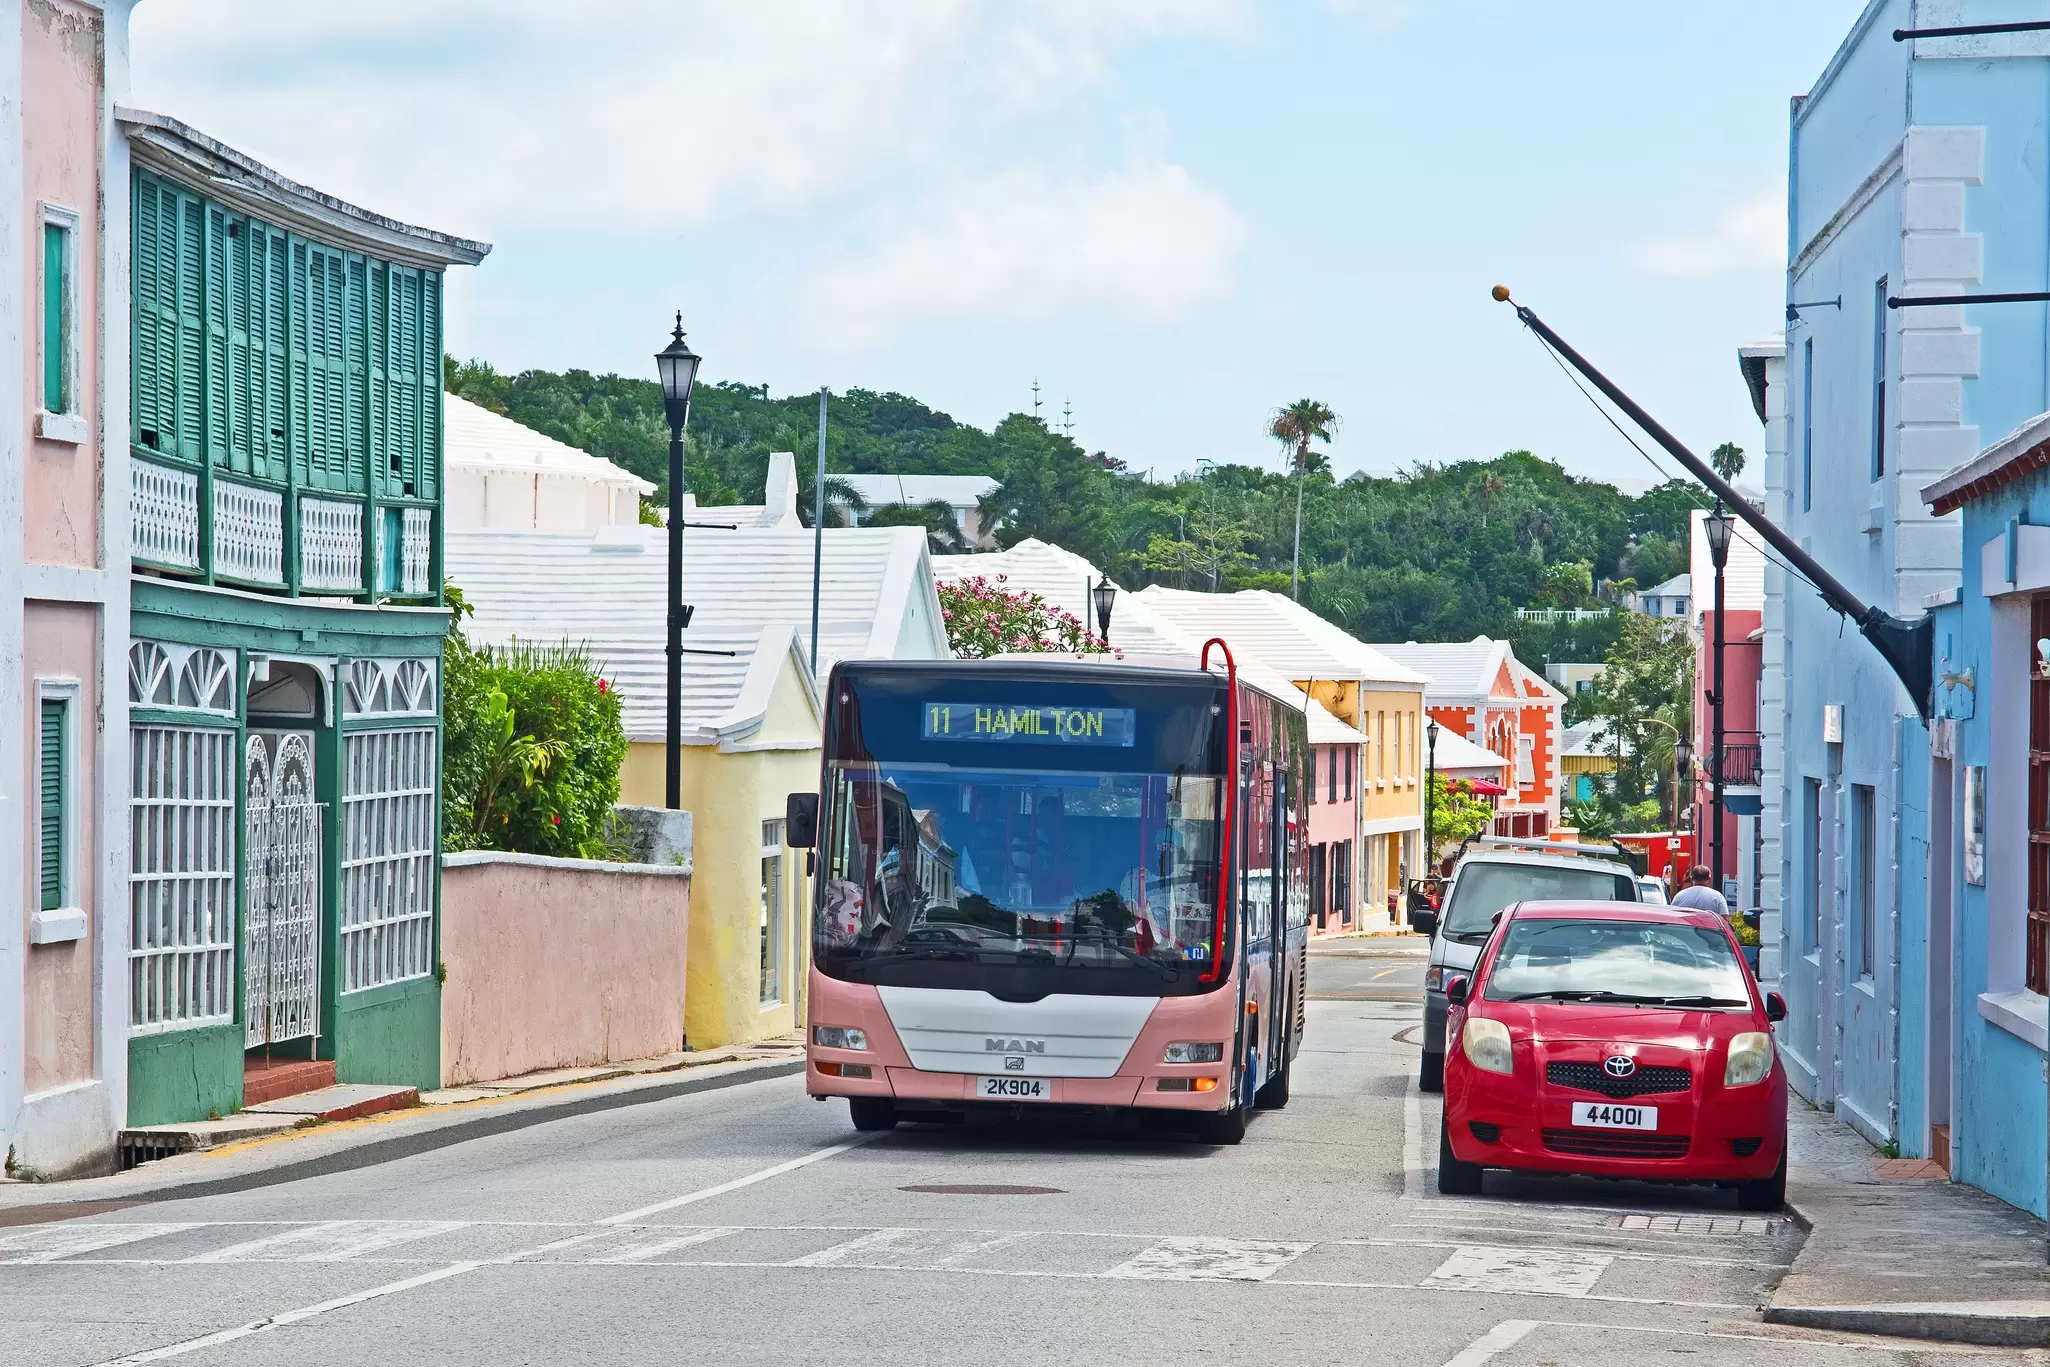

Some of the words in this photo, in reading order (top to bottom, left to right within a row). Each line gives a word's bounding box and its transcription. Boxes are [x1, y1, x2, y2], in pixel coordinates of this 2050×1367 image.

[930, 707, 950, 733] 11
[975, 708, 1103, 736] HAMILTON
[985, 1038, 1045, 1053] MAN
[987, 1078, 1041, 1096] 2K904
[1586, 1105, 1642, 1126] 44001
